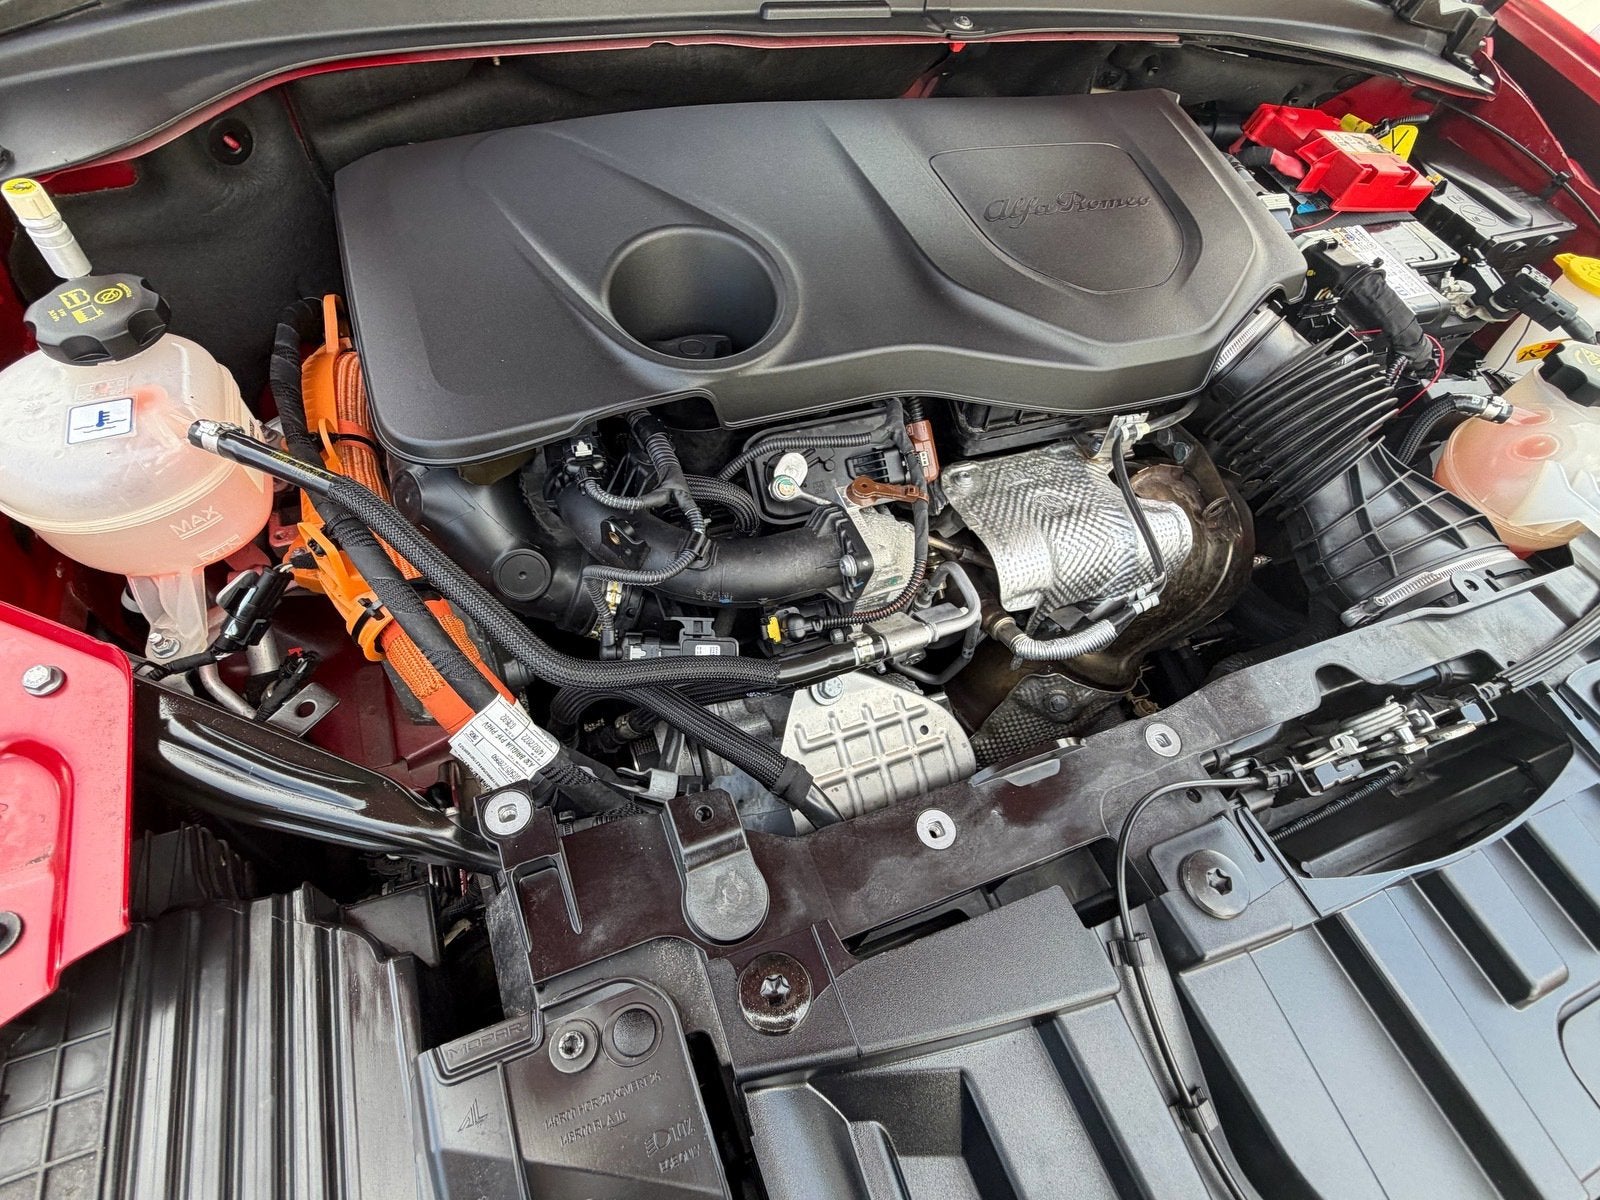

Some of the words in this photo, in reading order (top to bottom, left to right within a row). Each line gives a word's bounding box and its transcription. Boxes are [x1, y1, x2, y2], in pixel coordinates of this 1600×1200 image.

[983, 197, 1055, 229] Alfa
[1056, 190, 1151, 212] Romeo
[169, 506, 220, 535] MAX
[447, 1023, 527, 1058] MOPAR
